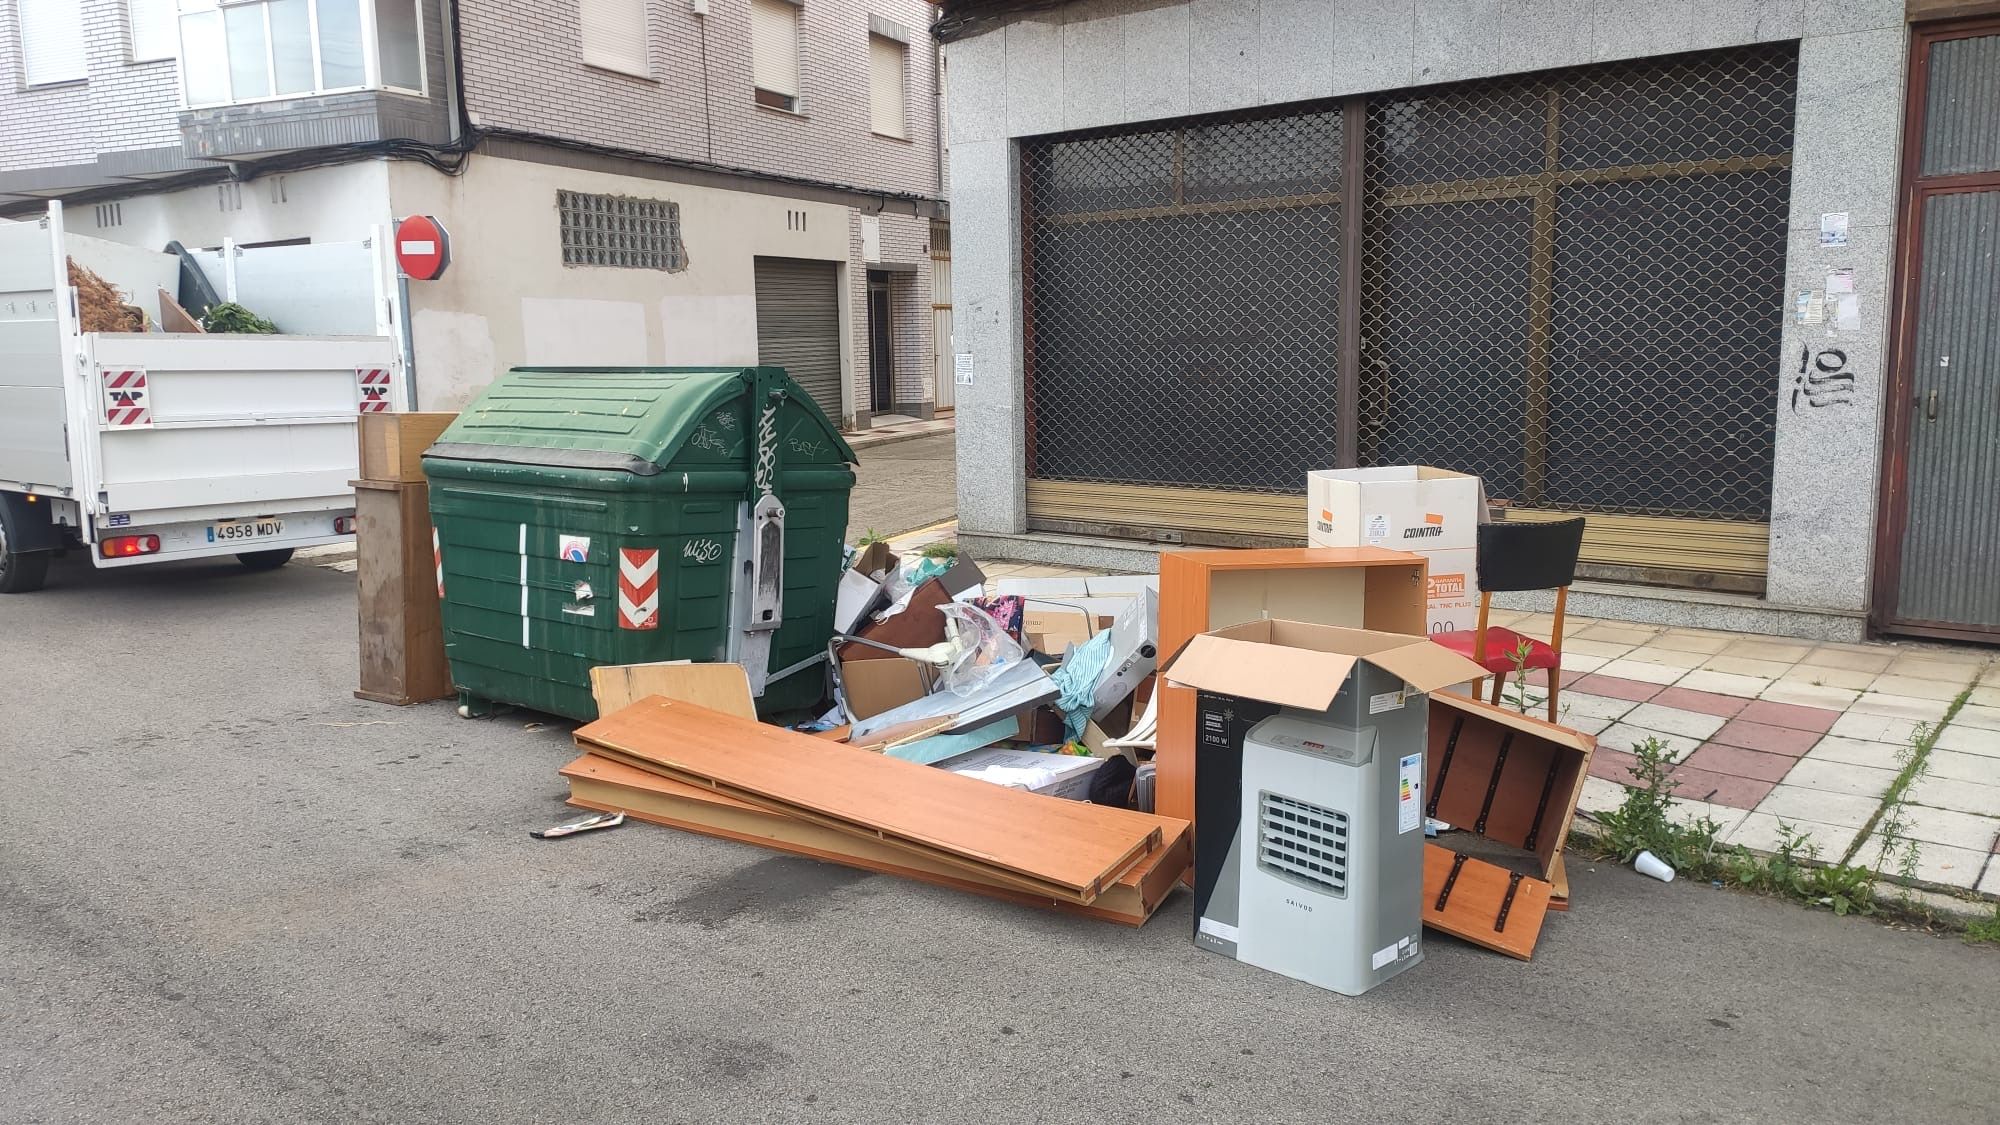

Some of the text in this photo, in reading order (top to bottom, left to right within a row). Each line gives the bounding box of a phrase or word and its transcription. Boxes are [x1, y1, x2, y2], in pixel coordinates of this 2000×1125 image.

[109, 390, 144, 407] TAP
[217, 522, 281, 539] 4958 MDV
[1403, 527, 1443, 538] COINTRA
[1435, 582, 1465, 593] TOTAL
